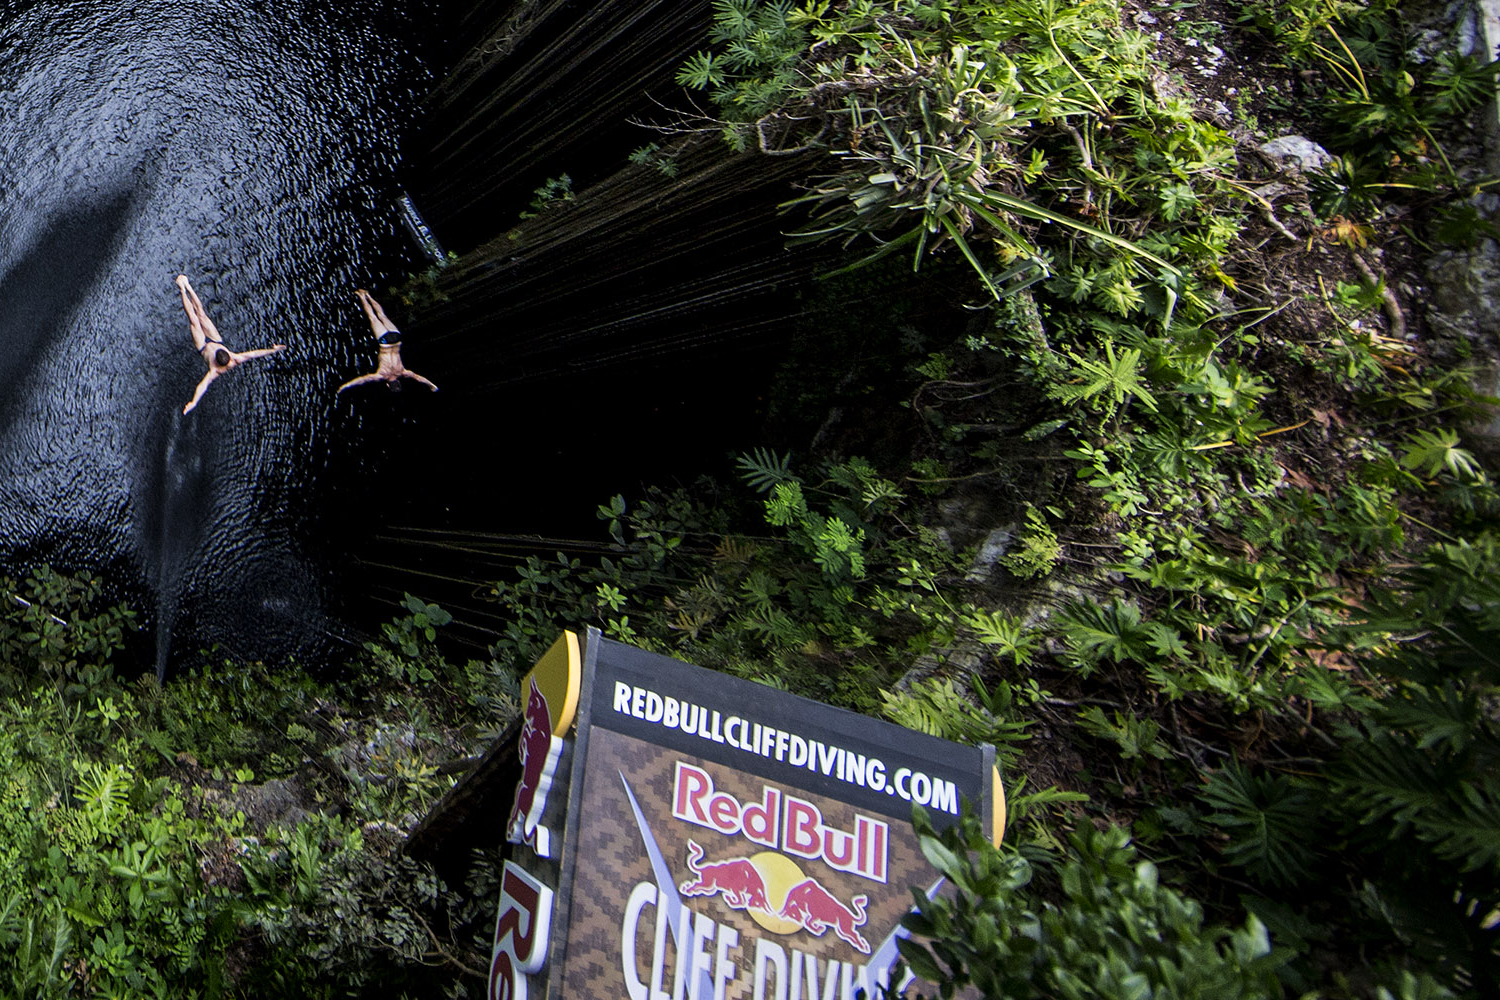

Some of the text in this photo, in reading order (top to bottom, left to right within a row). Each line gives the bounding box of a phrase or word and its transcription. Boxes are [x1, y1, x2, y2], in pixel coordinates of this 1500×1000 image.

[612, 680, 960, 816] REDBULLCLIFFDIVING.COM
[673, 761, 889, 884] Red Bull
[621, 881, 739, 1000] CLIFF
